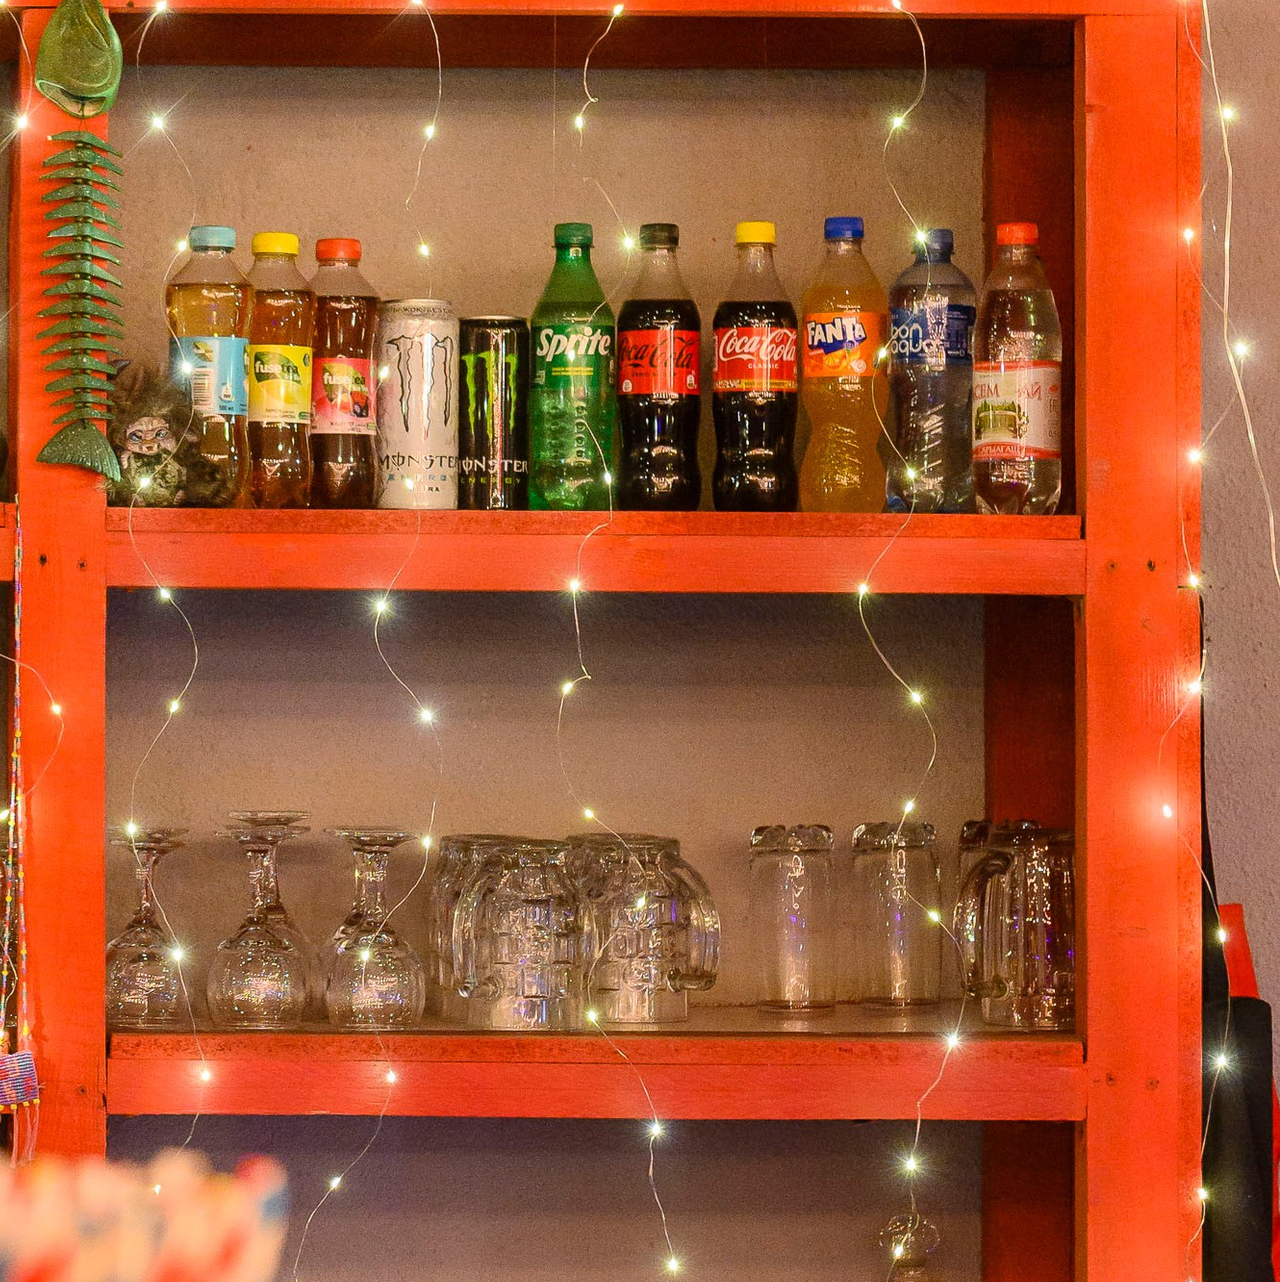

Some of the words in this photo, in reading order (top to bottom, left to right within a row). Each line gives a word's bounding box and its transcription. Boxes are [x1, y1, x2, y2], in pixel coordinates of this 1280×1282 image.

[536, 326, 611, 362] Sprite
[720, 328, 797, 362] Coca-Cola
[807, 317, 867, 346] FANTA
